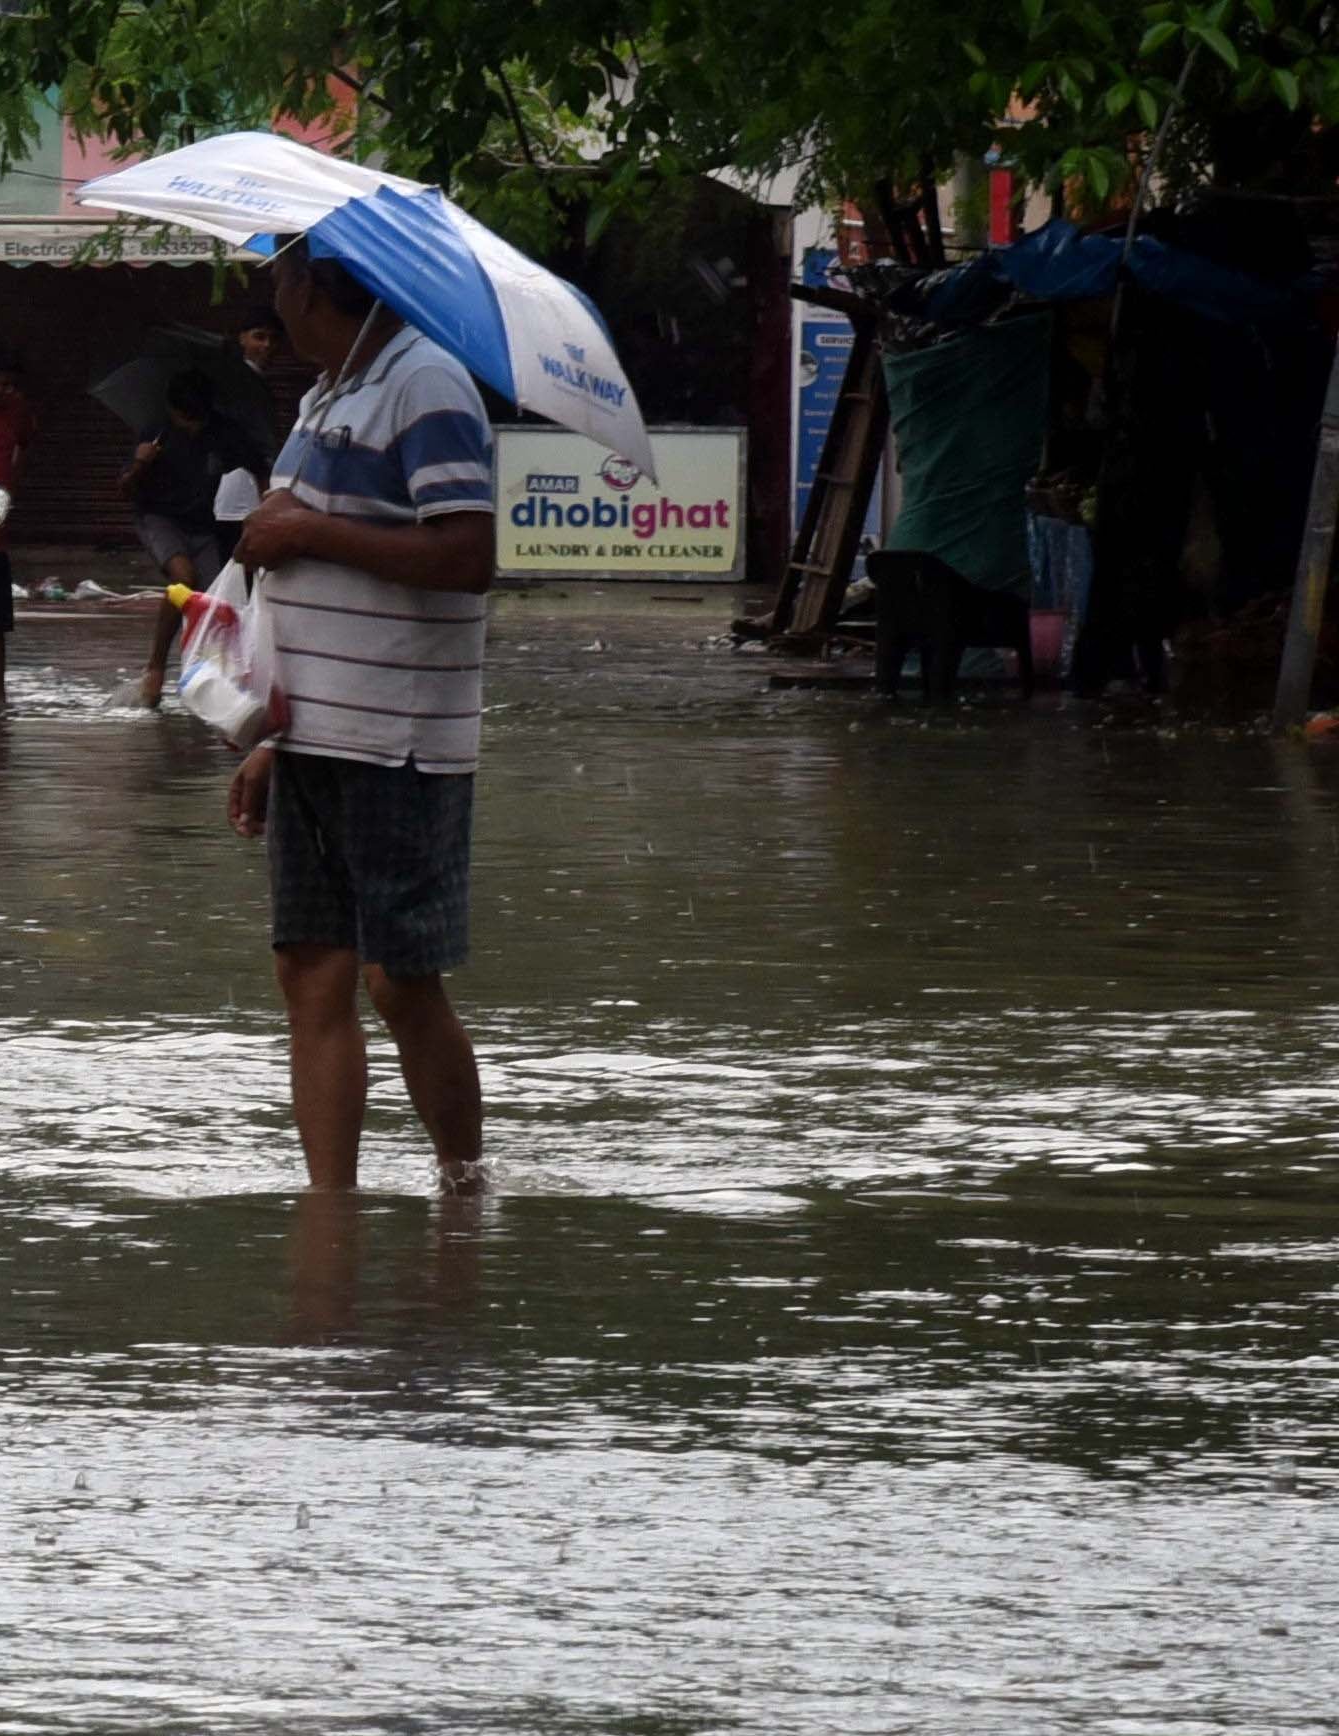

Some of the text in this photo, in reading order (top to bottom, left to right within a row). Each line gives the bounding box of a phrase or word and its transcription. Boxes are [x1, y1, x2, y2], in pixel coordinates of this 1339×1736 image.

[528, 478, 577, 492] AMAR
[510, 494, 729, 539] dhobighat
[515, 543, 724, 559] LAUNDRY & DRY CLEANER
